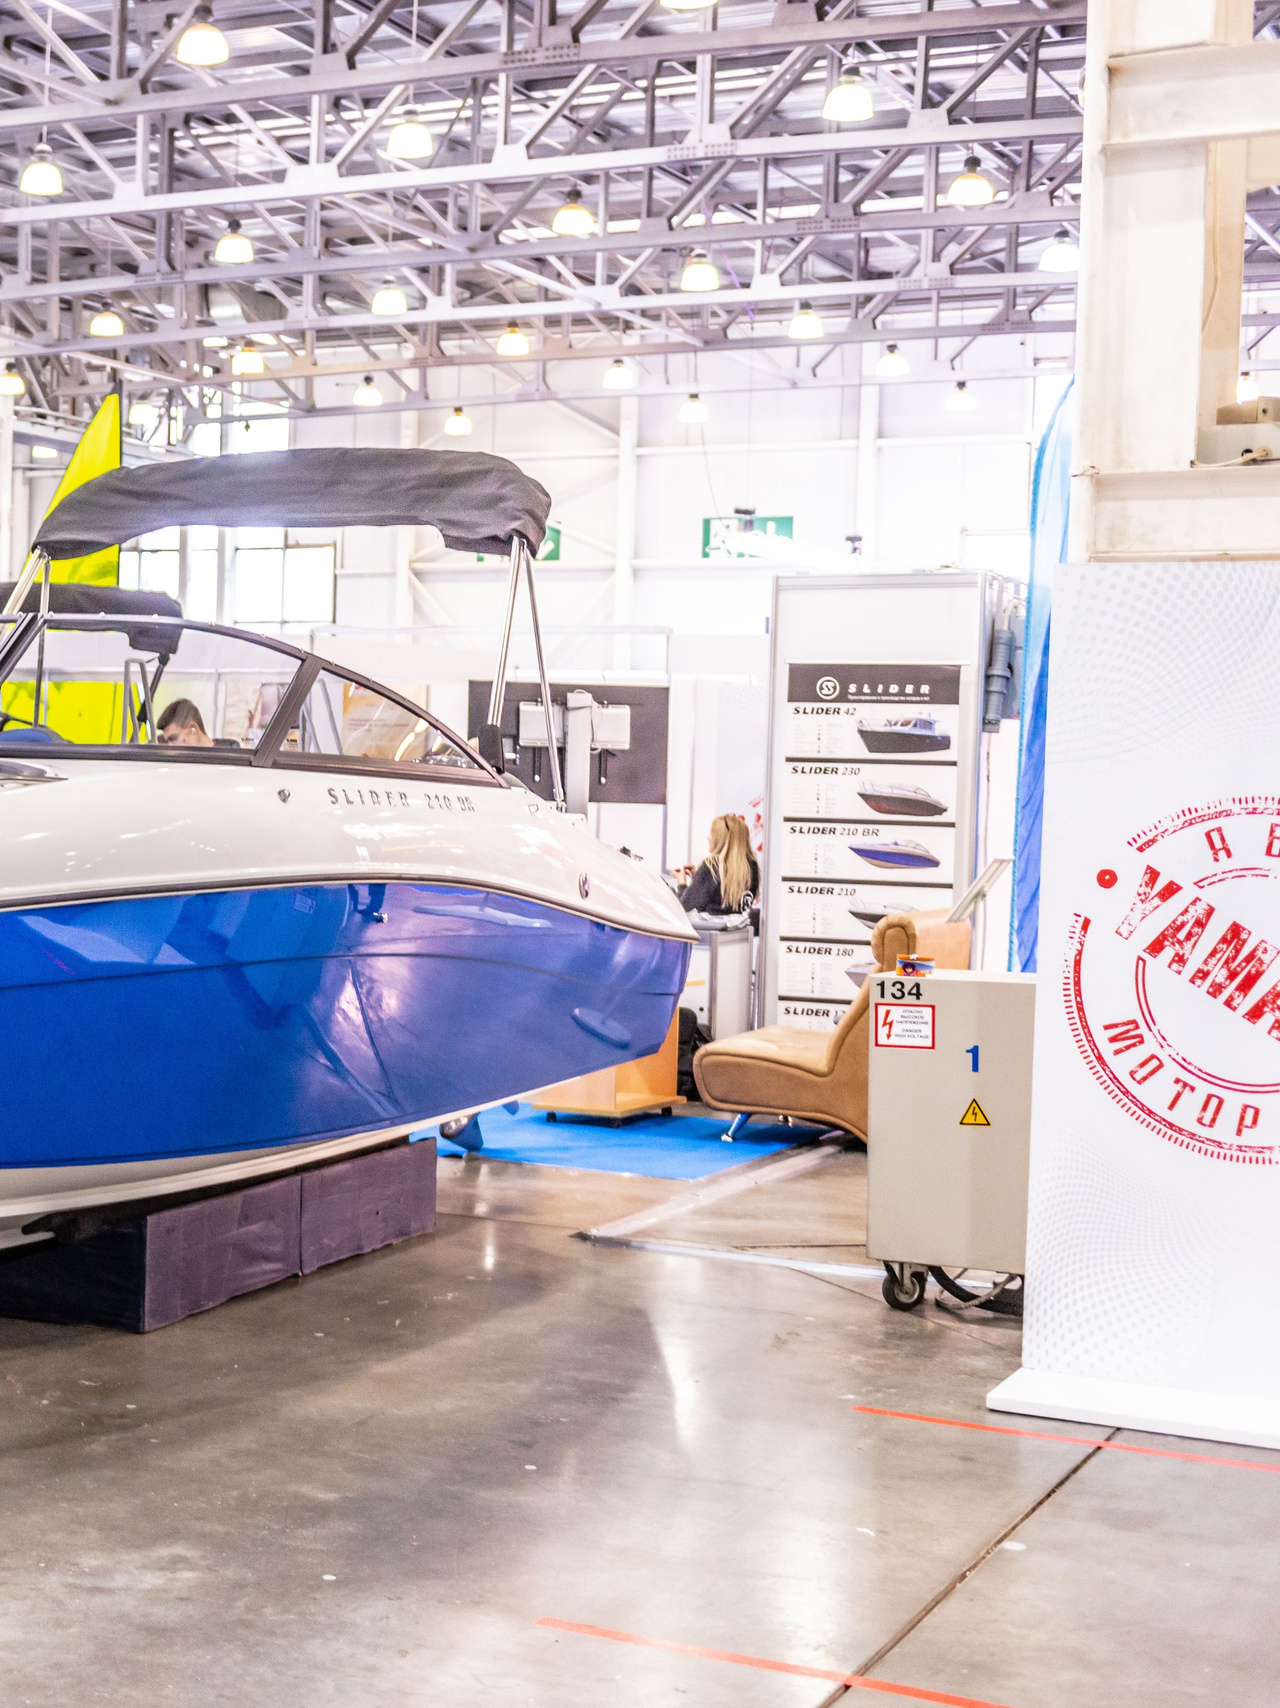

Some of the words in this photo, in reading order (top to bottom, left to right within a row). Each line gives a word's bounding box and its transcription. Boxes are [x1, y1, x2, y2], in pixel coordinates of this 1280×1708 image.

[847, 683, 931, 694] SLIDER
[793, 706, 841, 715] SLIDER
[844, 707, 857, 716] 42
[791, 766, 839, 775] SLIDER
[842, 767, 860, 776] 230
[327, 787, 411, 808] SLIDER
[789, 826, 837, 835] SLIDER
[839, 827, 858, 836] 210
[861, 828, 880, 837] BR
[787, 885, 835, 895] SLIDER
[837, 888, 856, 897] 210
[785, 945, 832, 956] SLIDER
[836, 948, 854, 957] 180
[876, 980, 923, 1000] 134
[783, 1006, 830, 1017] SLIDER
[965, 1045, 979, 1072] 1
